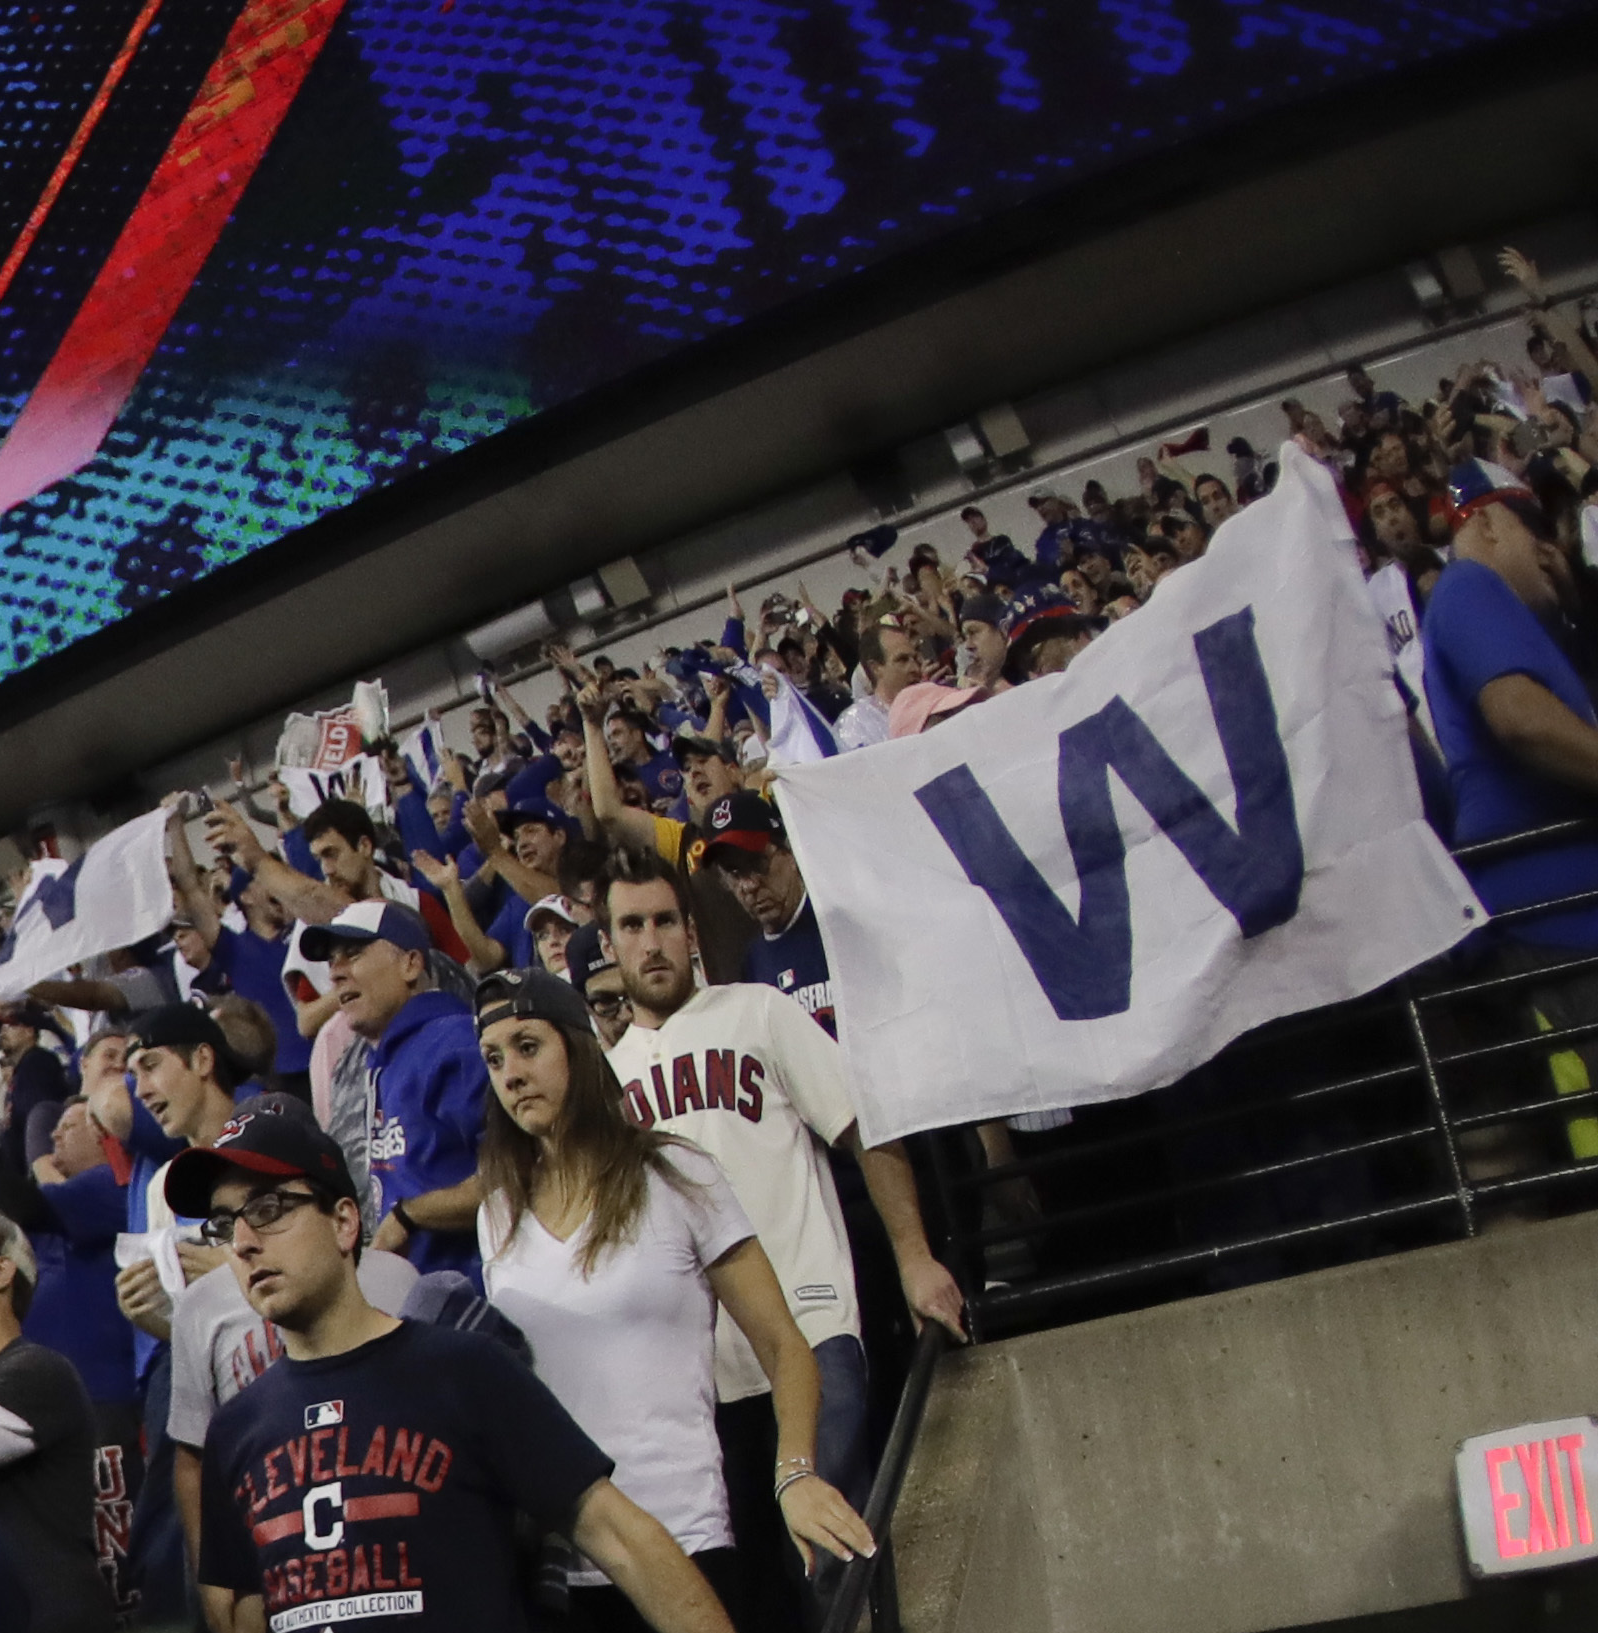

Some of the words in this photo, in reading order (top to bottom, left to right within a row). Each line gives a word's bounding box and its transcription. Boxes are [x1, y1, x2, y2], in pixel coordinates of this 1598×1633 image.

[913, 603, 1305, 1022] W
[303, 1482, 346, 1550] C
[1483, 1433, 1594, 1560] EXIT
[337, 1592, 416, 1619] COLLECTION
